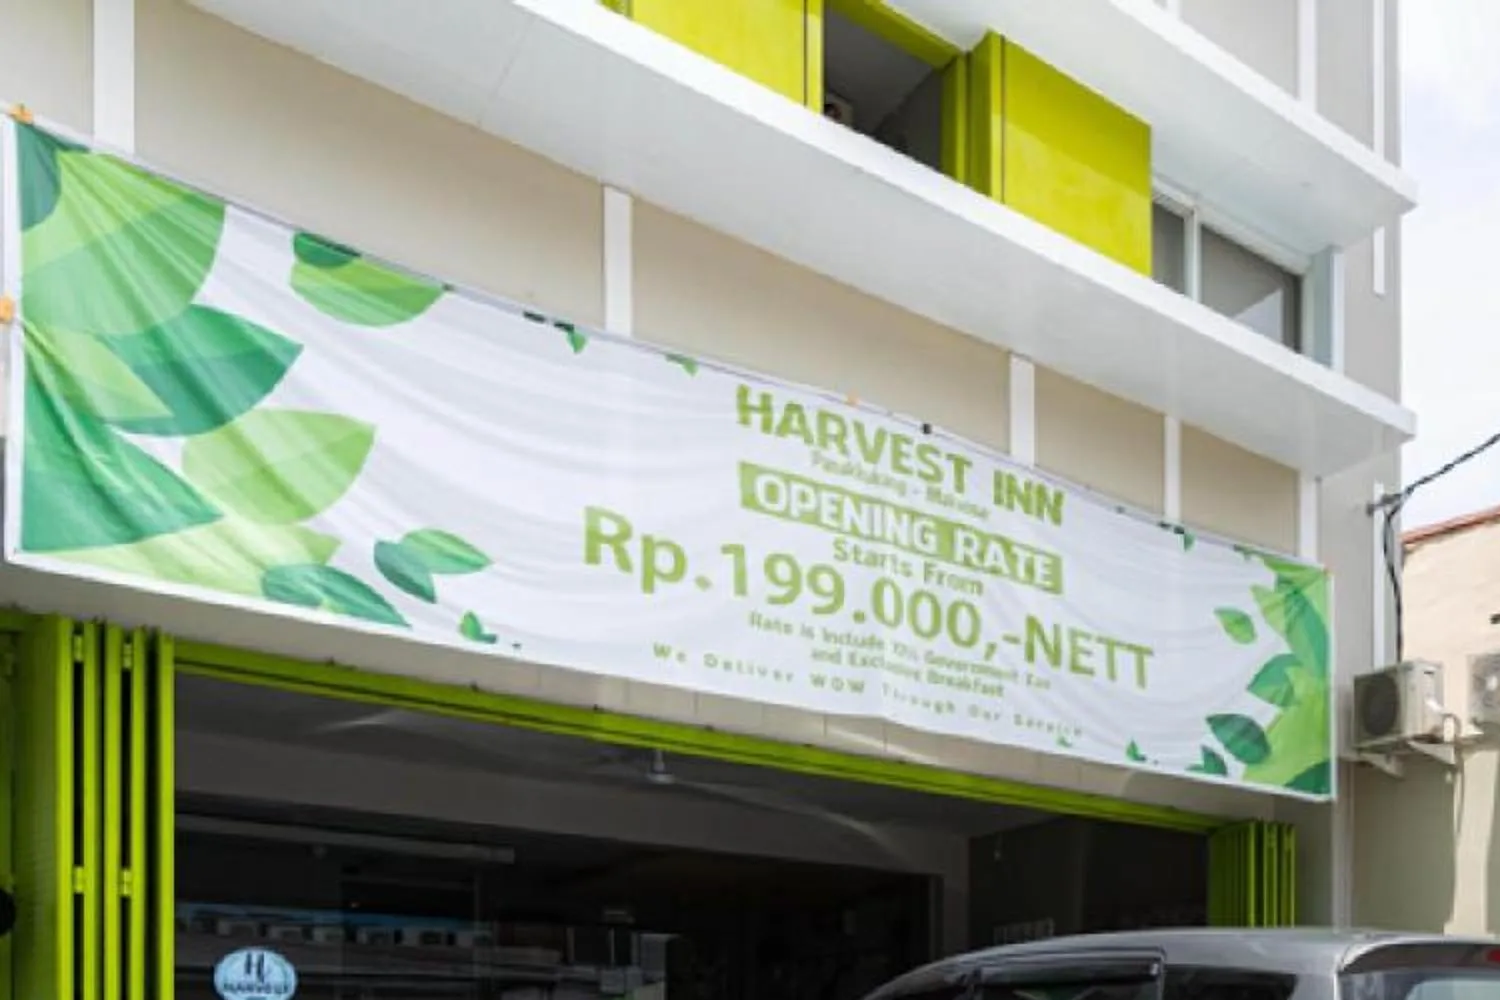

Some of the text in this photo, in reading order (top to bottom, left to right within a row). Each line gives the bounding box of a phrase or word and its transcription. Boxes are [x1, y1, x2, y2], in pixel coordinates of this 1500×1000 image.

[736, 383, 1066, 527] HARVEST INN
[753, 473, 1056, 590] OPENING RATE
[833, 539, 984, 597] Starts From
[809, 672, 866, 693] WOW
